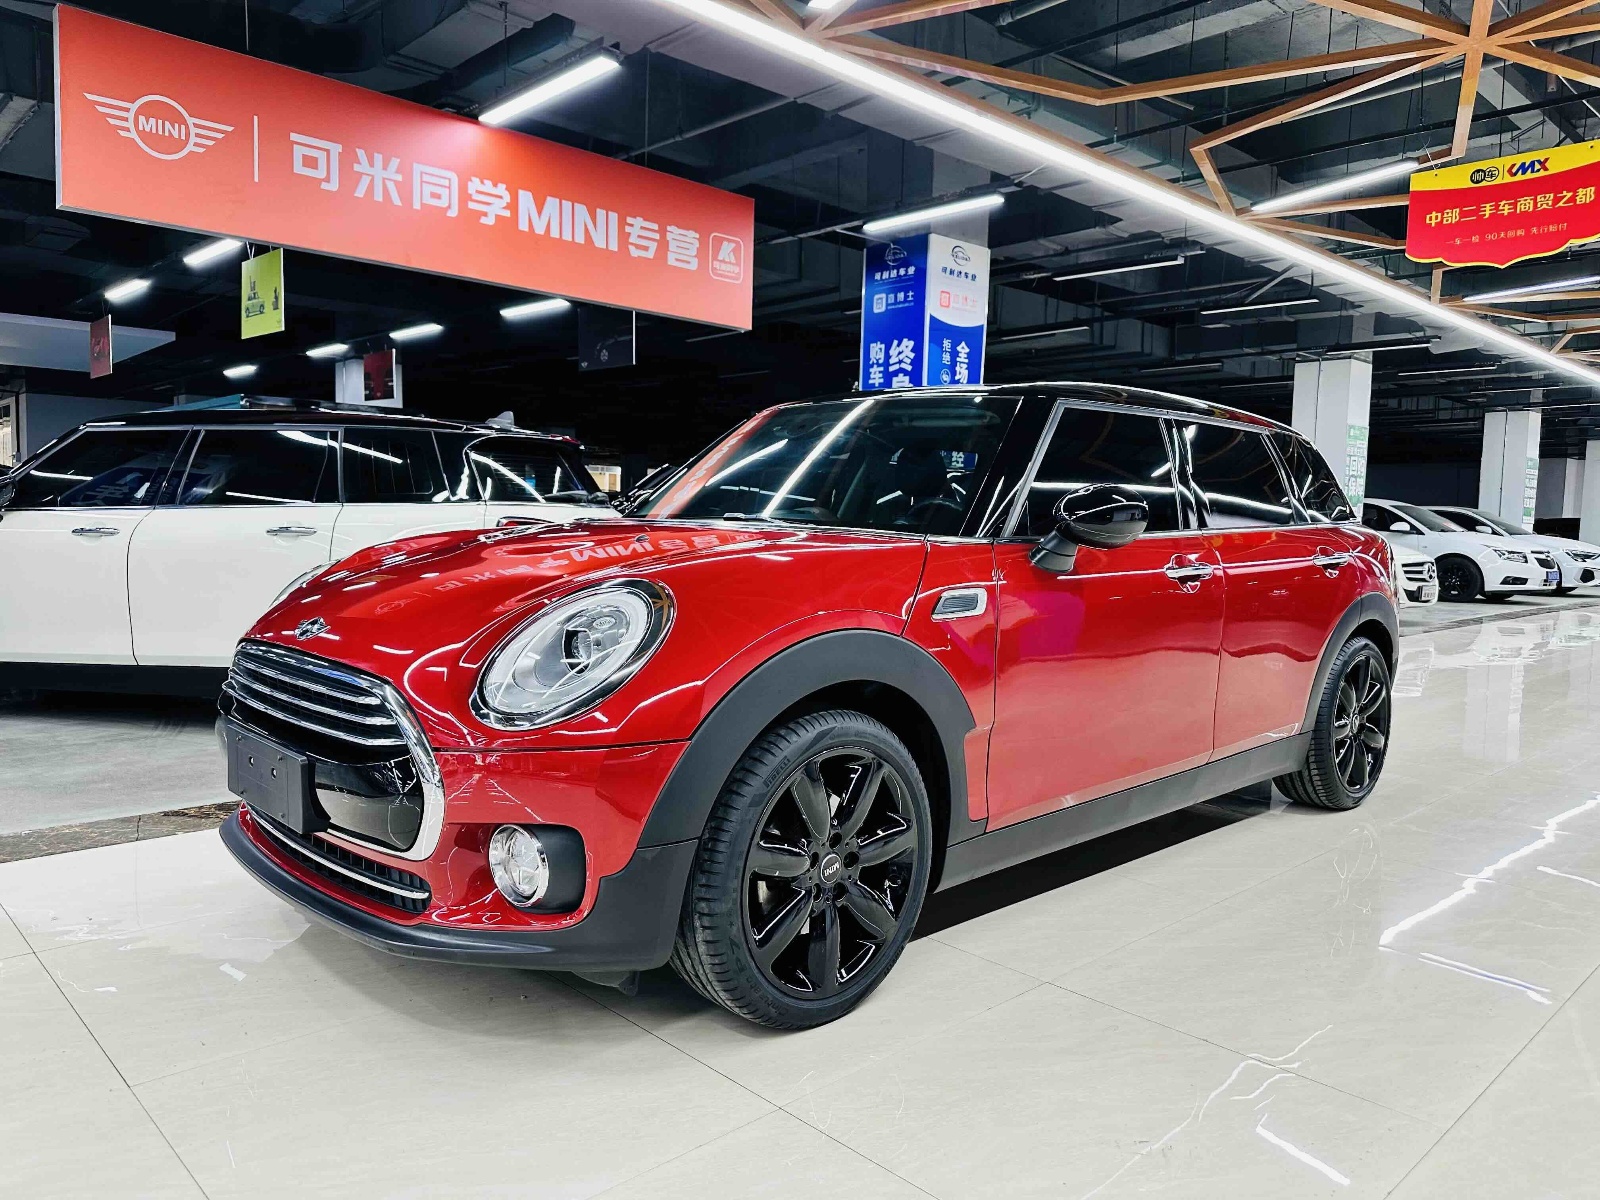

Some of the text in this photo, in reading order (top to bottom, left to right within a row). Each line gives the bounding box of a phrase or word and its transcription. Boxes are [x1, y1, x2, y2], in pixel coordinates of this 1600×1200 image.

[138, 114, 186, 141] MINI
[290, 132, 700, 272] 可米同学MINI专营
[1425, 186, 1596, 228] 中部二手车商贸之都
[868, 341, 886, 387] 购车
[824, 861, 840, 877] MINI
